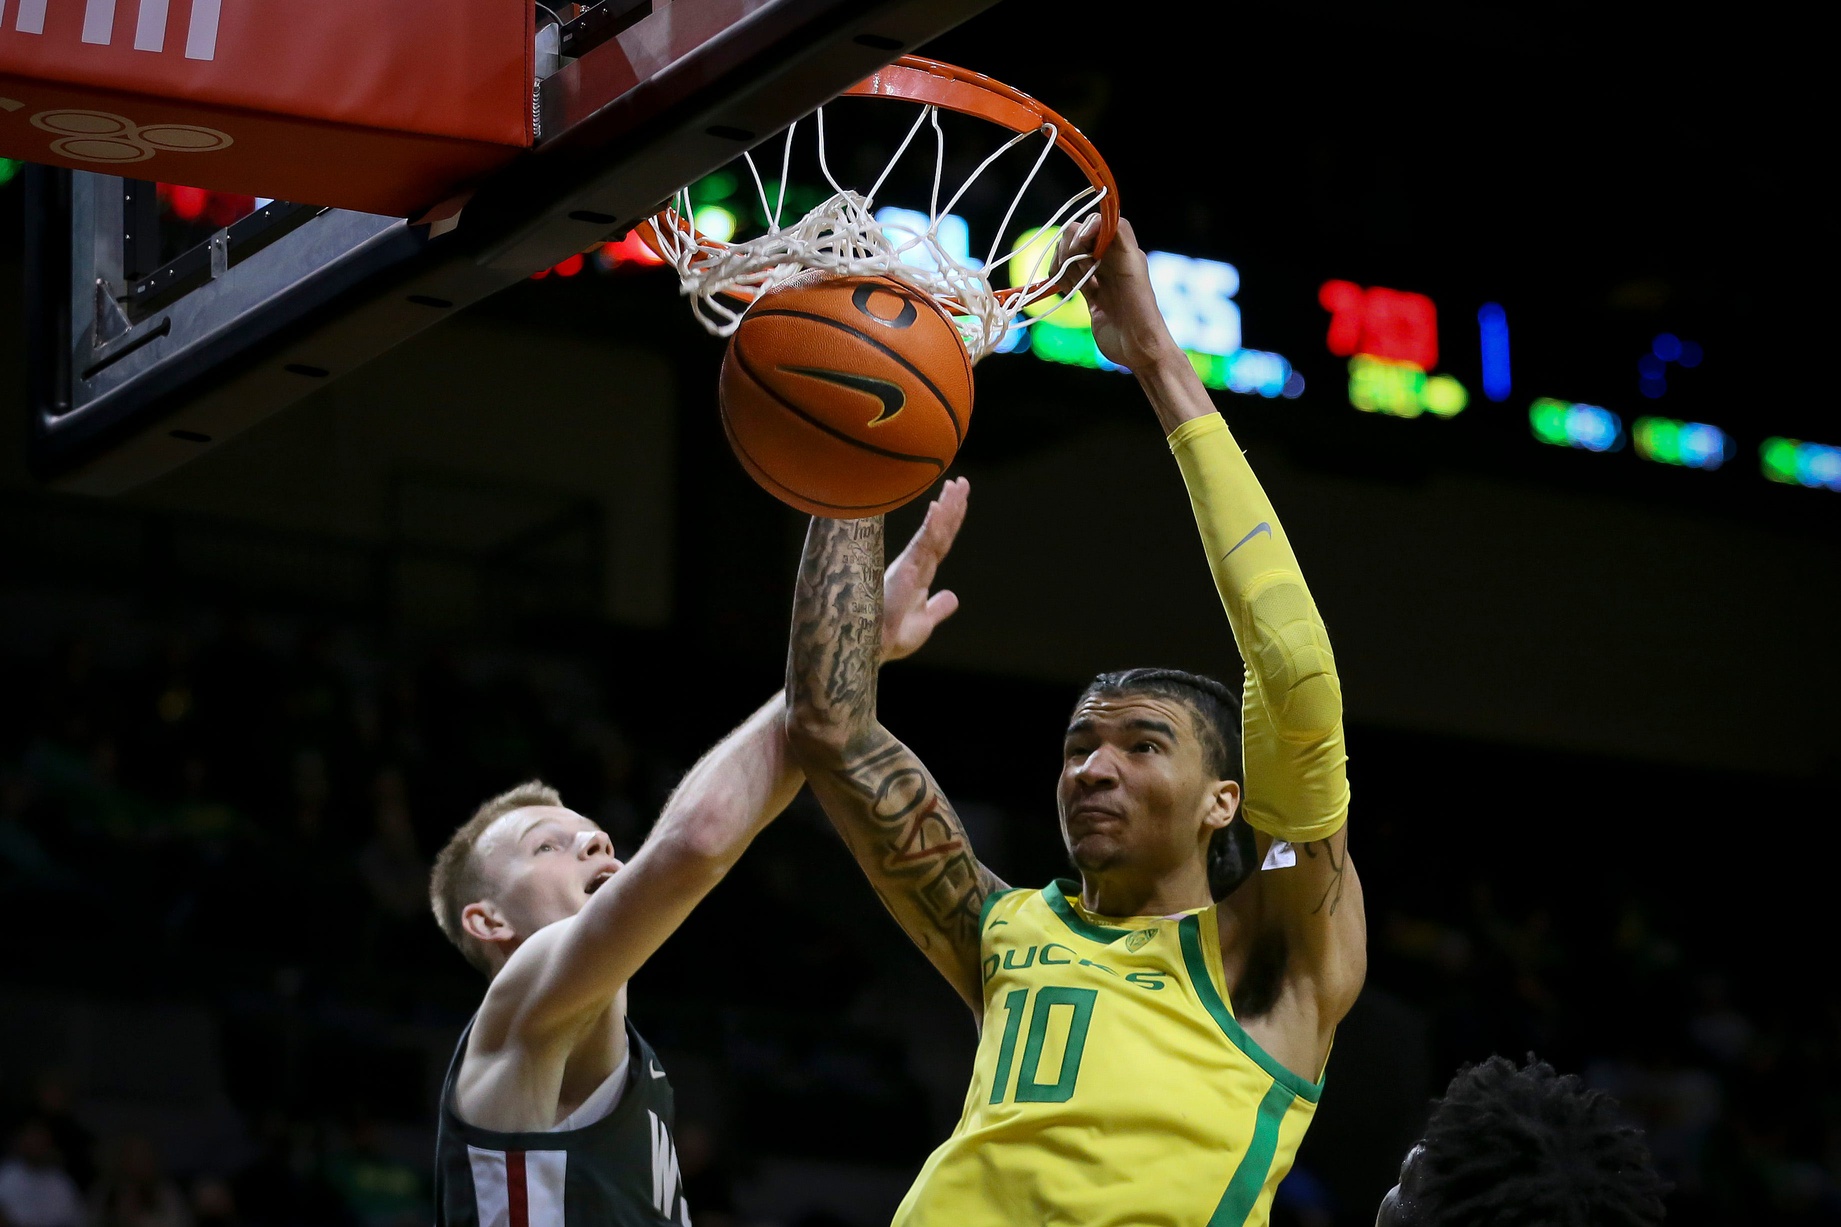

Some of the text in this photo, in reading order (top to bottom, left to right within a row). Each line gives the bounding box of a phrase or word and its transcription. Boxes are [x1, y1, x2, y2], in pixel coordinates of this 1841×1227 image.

[851, 283, 918, 329] O
[989, 986, 1098, 1105] 10
[648, 1109, 692, 1227] W
